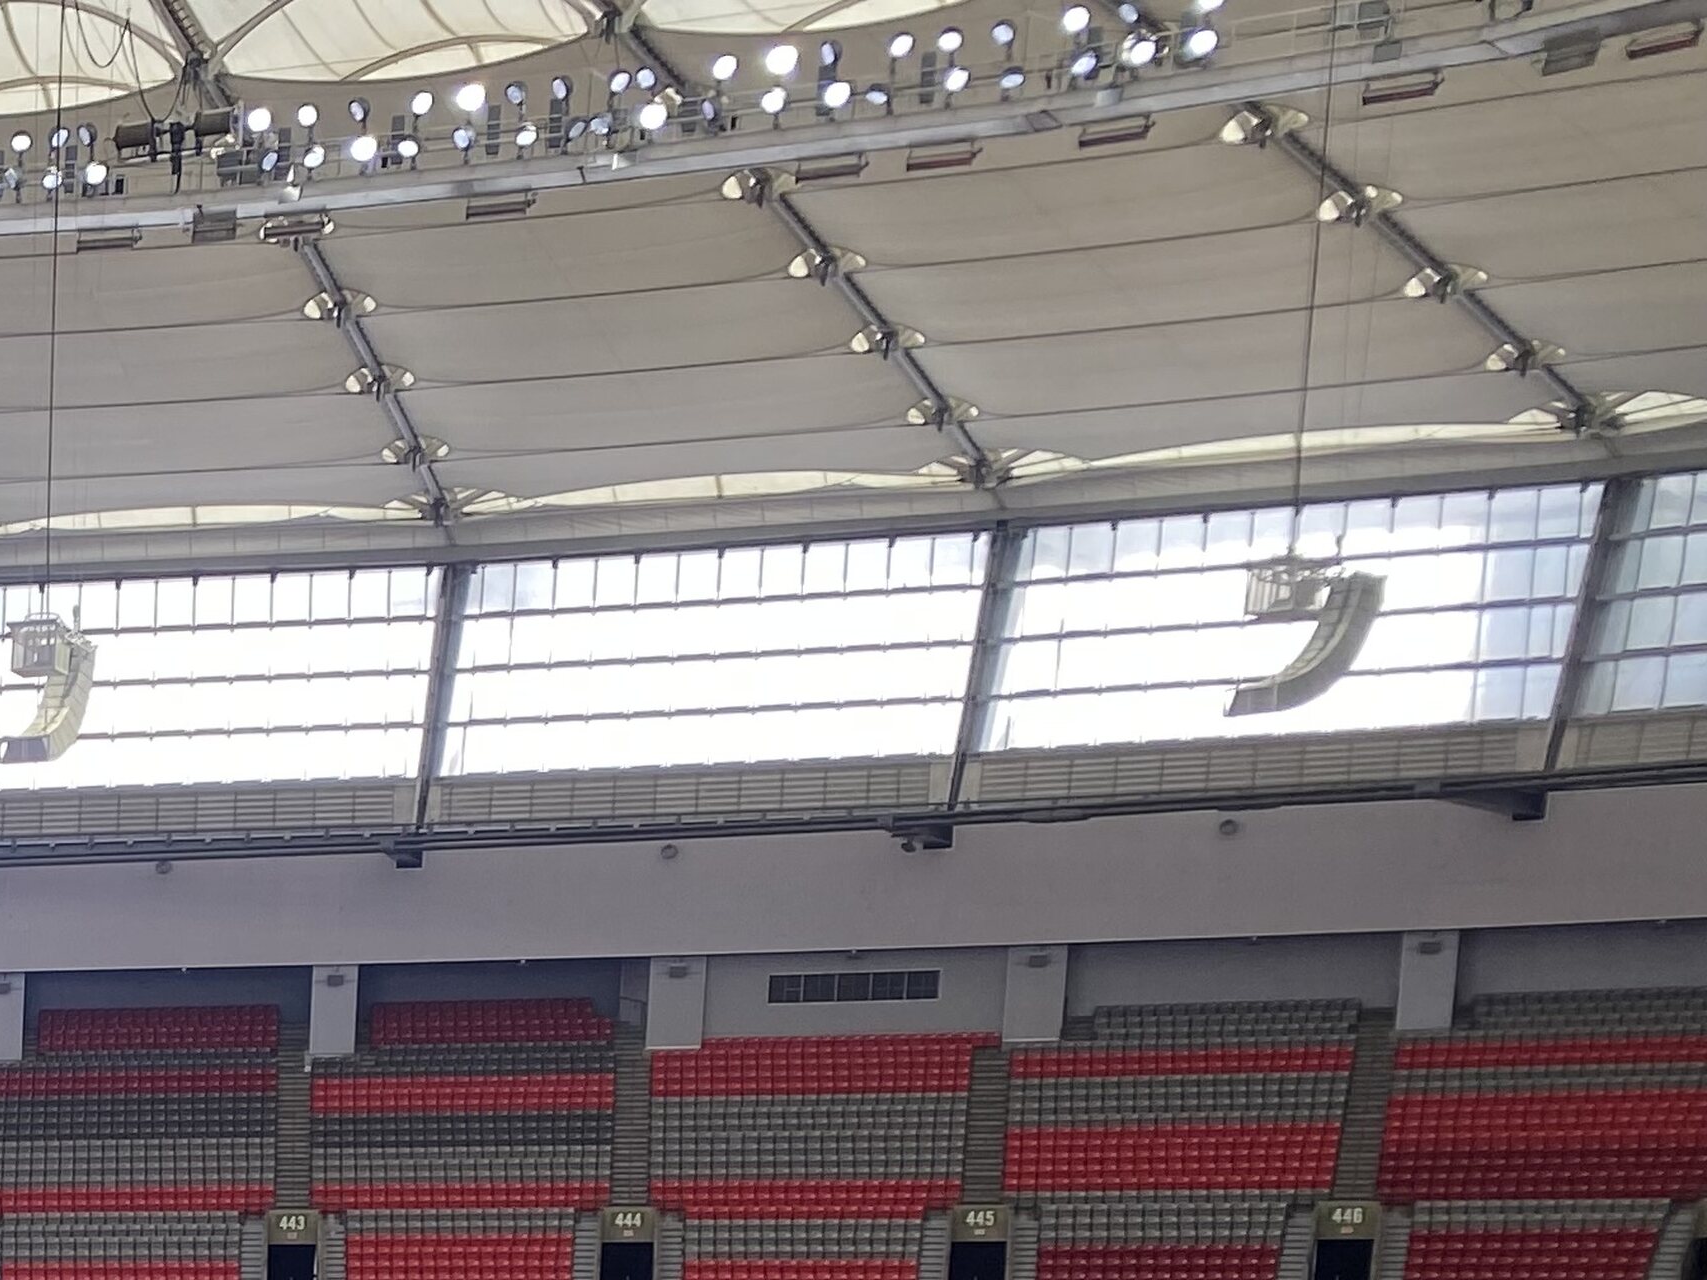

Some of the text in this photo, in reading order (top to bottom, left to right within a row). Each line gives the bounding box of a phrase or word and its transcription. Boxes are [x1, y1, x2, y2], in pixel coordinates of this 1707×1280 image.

[279, 1215, 305, 1230] 443
[615, 1213, 641, 1227] 444
[966, 1211, 995, 1226] 445
